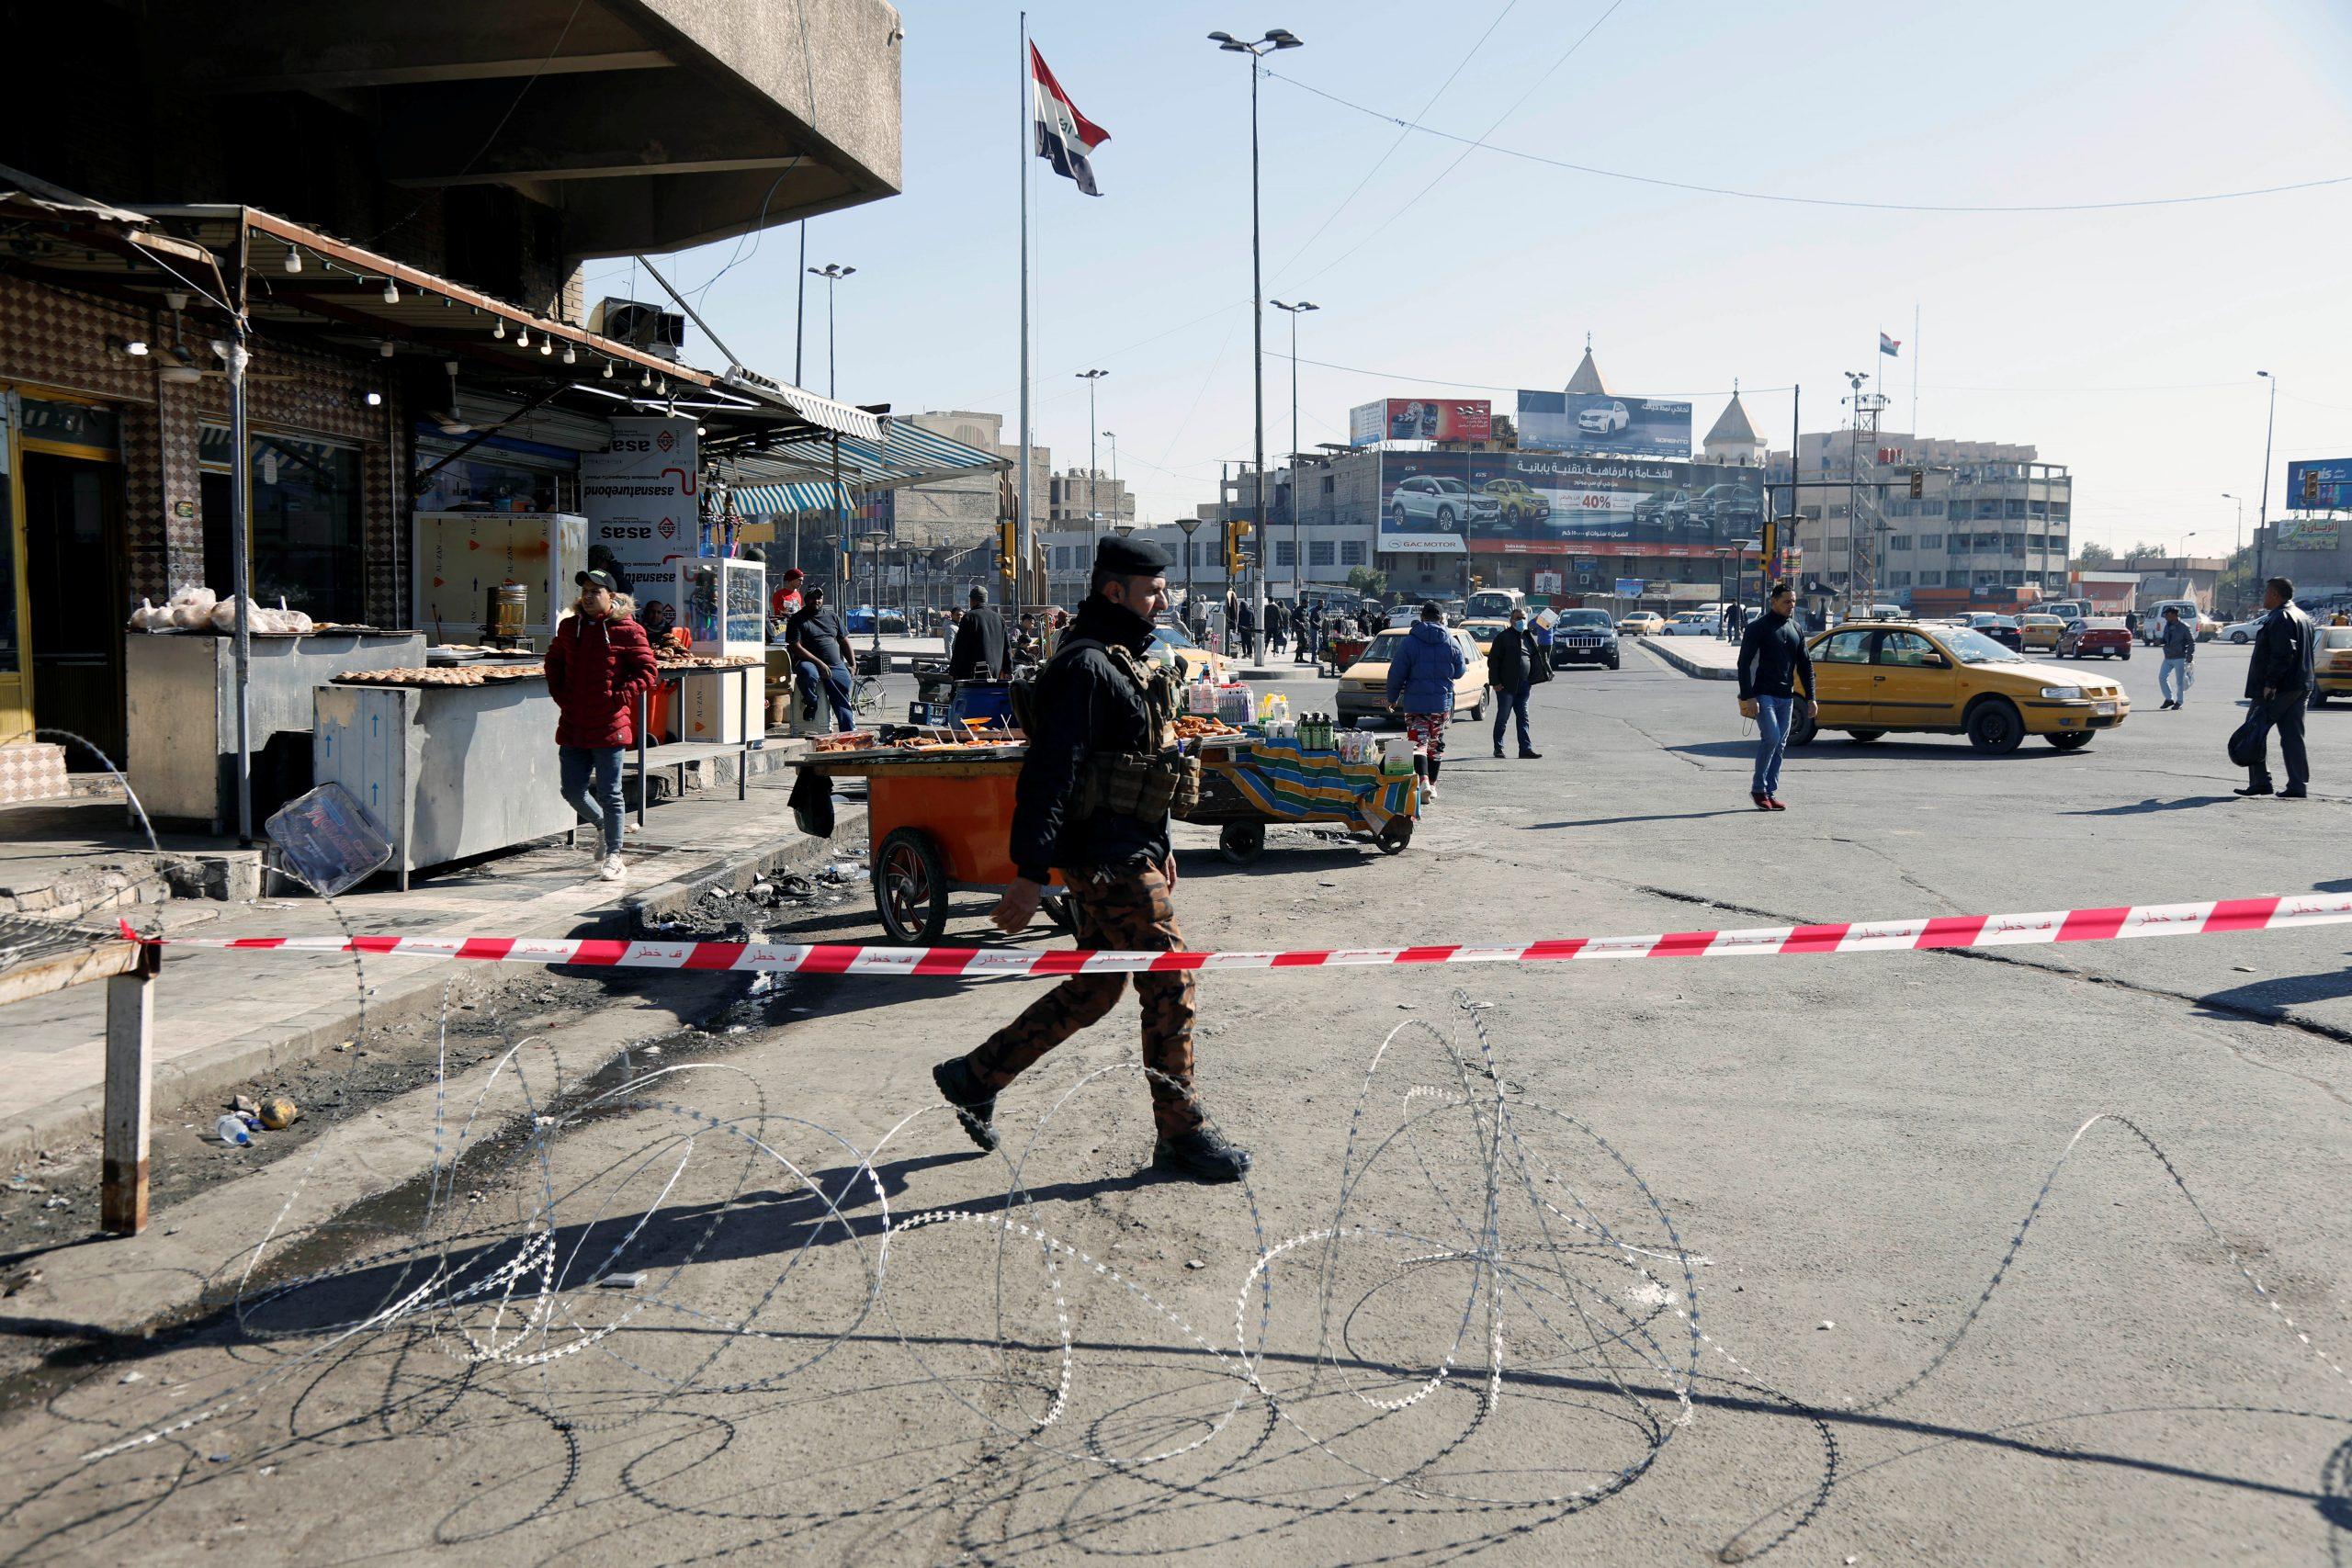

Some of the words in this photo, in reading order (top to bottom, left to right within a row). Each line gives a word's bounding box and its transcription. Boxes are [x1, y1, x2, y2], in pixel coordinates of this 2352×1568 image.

[612, 440, 650, 452] asa
[1518, 460, 1550, 475] يابانية
[1552, 463, 1585, 478] بتقنية
[1586, 463, 1626, 479] الرفاهية
[1634, 468, 1673, 479] الفخامة
[1628, 470, 1634, 479] و
[584, 485, 674, 498] asasnaturebond
[1582, 495, 1611, 509] 40%
[601, 526, 651, 539] asas
[624, 573, 675, 584] asasnatu
[2289, 903, 2323, 917] خطر
[2139, 914, 2172, 927] خطر
[2180, 913, 2198, 922] قف
[1993, 920, 2025, 934] خطر
[2036, 921, 2052, 931] قف
[1856, 930, 1886, 942] خطر
[522, 944, 548, 955] خطر
[635, 946, 662, 959] خطر
[669, 949, 682, 960] قف
[748, 950, 776, 964] خطر
[784, 952, 797, 963] قف
[864, 953, 890, 964] خطر
[899, 955, 912, 964] قف
[979, 954, 1007, 965] خطر
